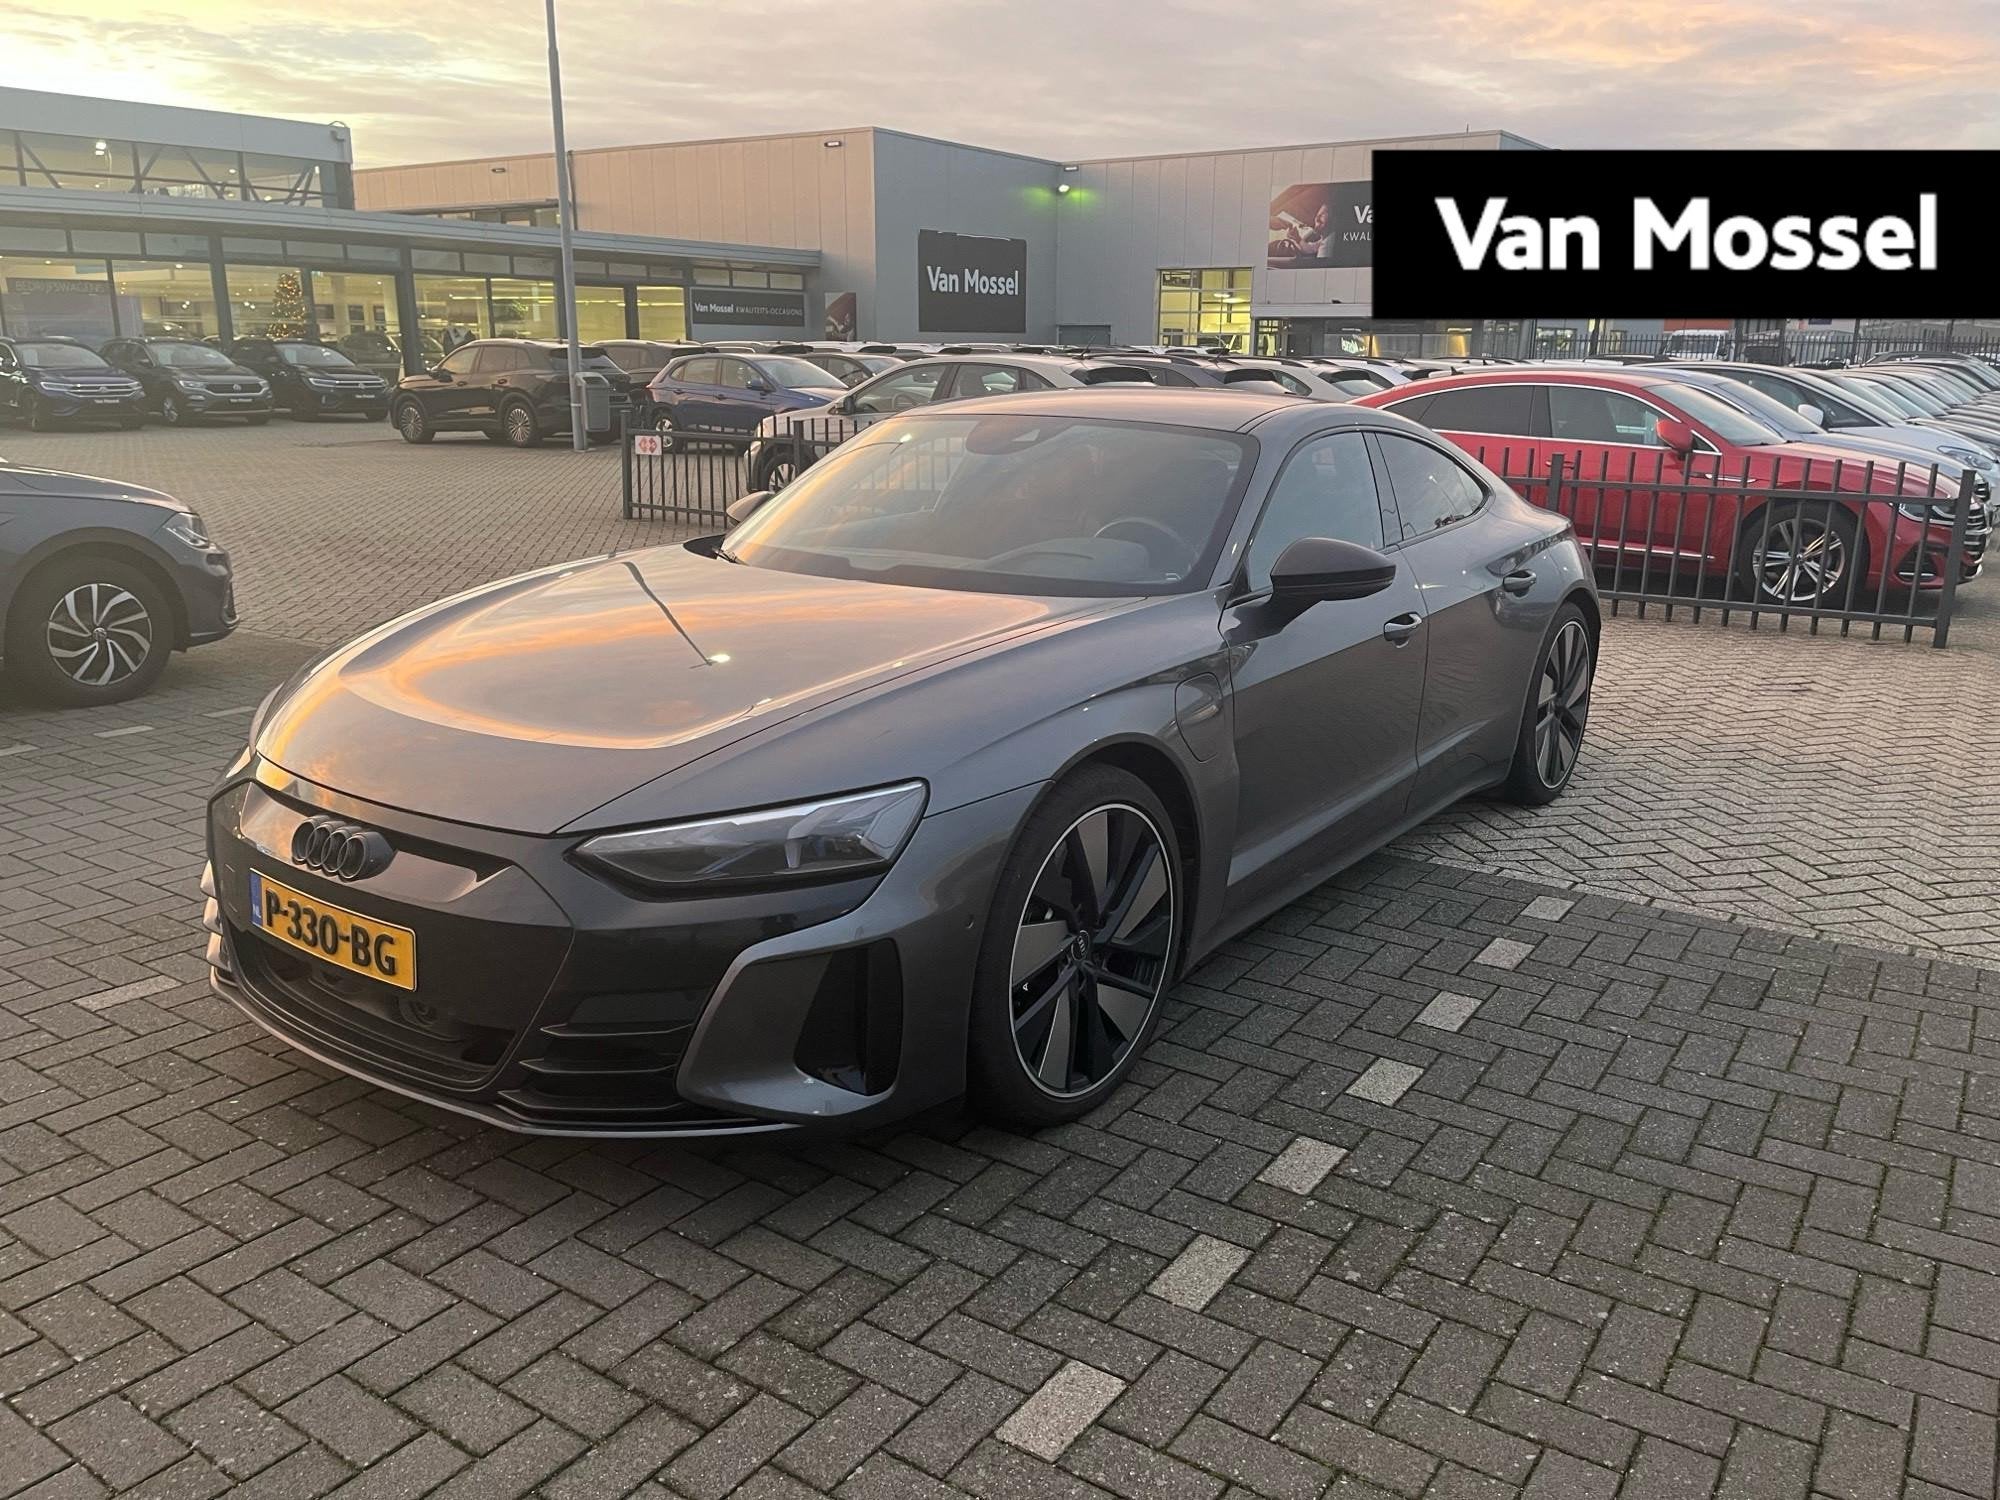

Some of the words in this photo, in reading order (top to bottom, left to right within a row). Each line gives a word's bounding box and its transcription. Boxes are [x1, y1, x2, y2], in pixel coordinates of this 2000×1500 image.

[926, 265, 959, 293] Van
[964, 268, 1019, 296] Mossel
[694, 303, 708, 312] Van
[709, 304, 734, 313] Mossel
[266, 887, 397, 976] P-330-BG
